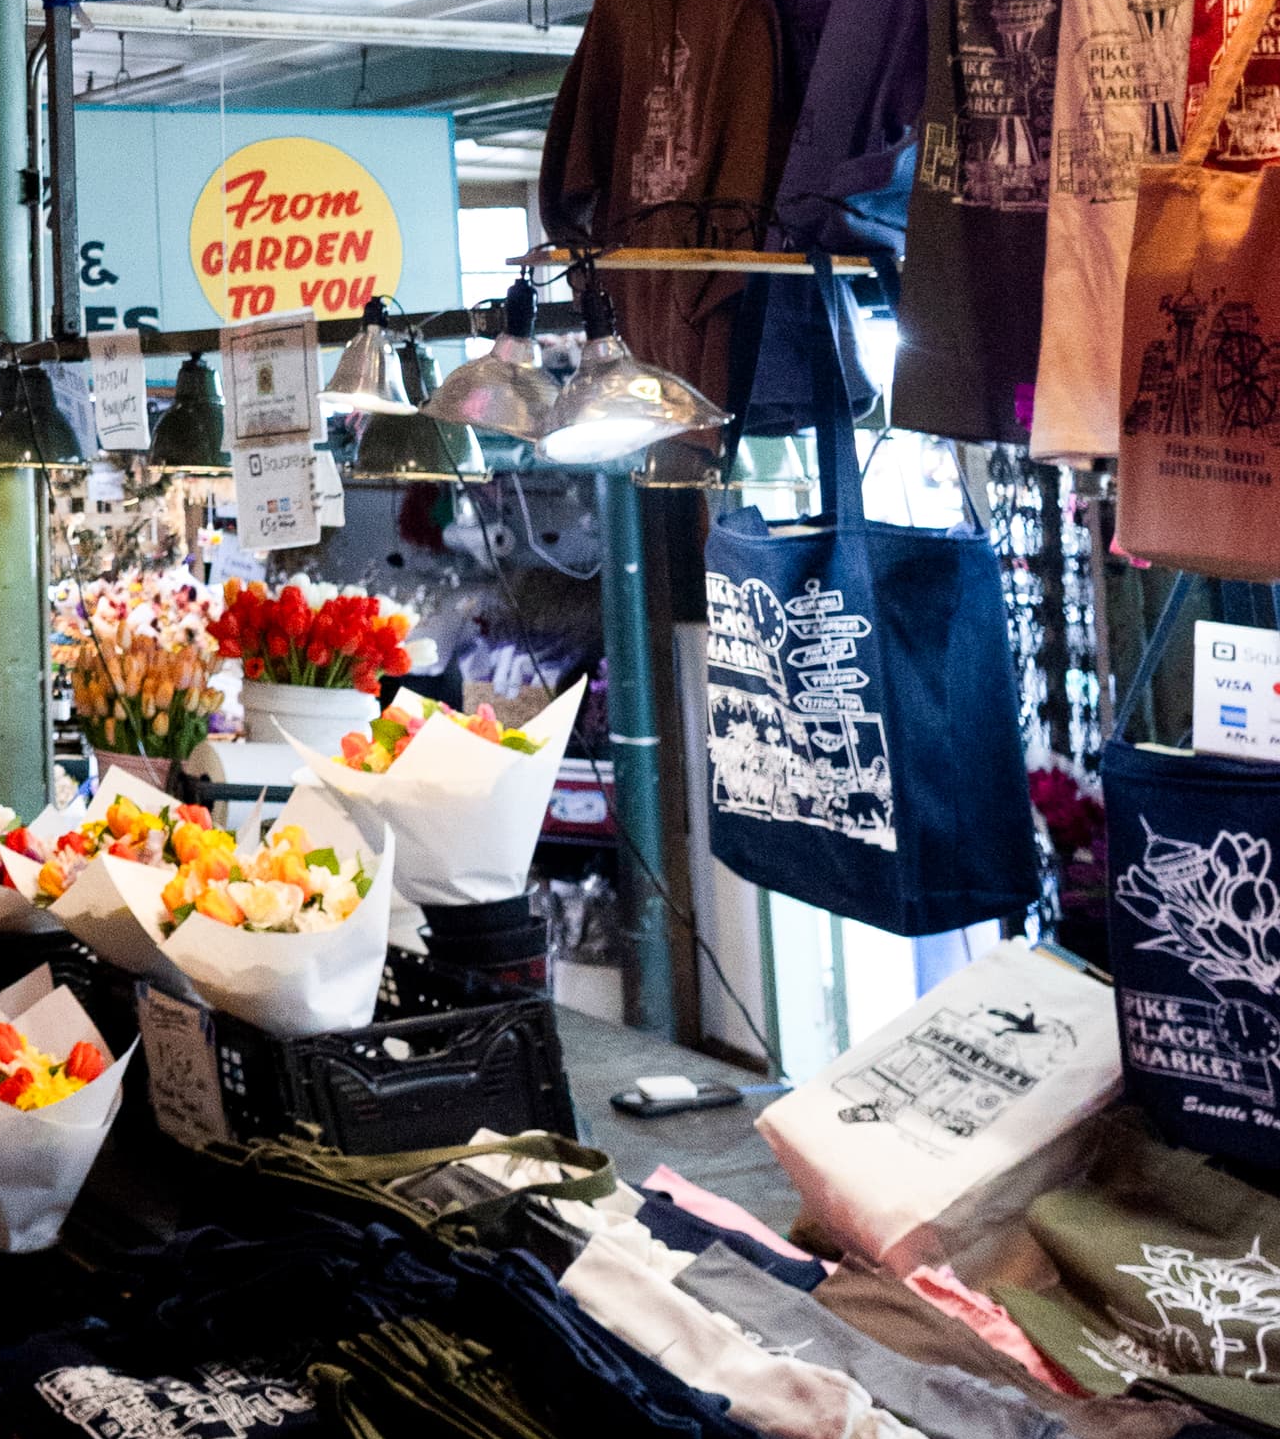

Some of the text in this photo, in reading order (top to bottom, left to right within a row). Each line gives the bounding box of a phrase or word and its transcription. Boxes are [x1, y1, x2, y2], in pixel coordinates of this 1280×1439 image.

[962, 58, 992, 75] IKE
[1090, 46, 1132, 61] PIKE
[223, 168, 362, 229] From
[80, 240, 119, 287] &
[201, 229, 374, 278] GARDEN
[227, 275, 376, 320] TO YOU
[1215, 678, 1253, 692] VISA
[1123, 994, 1185, 1023] PIKE
[1127, 1016, 1217, 1052] PLACE
[1131, 1041, 1243, 1082] MARKET
[1182, 1094, 1248, 1122] Seattle
